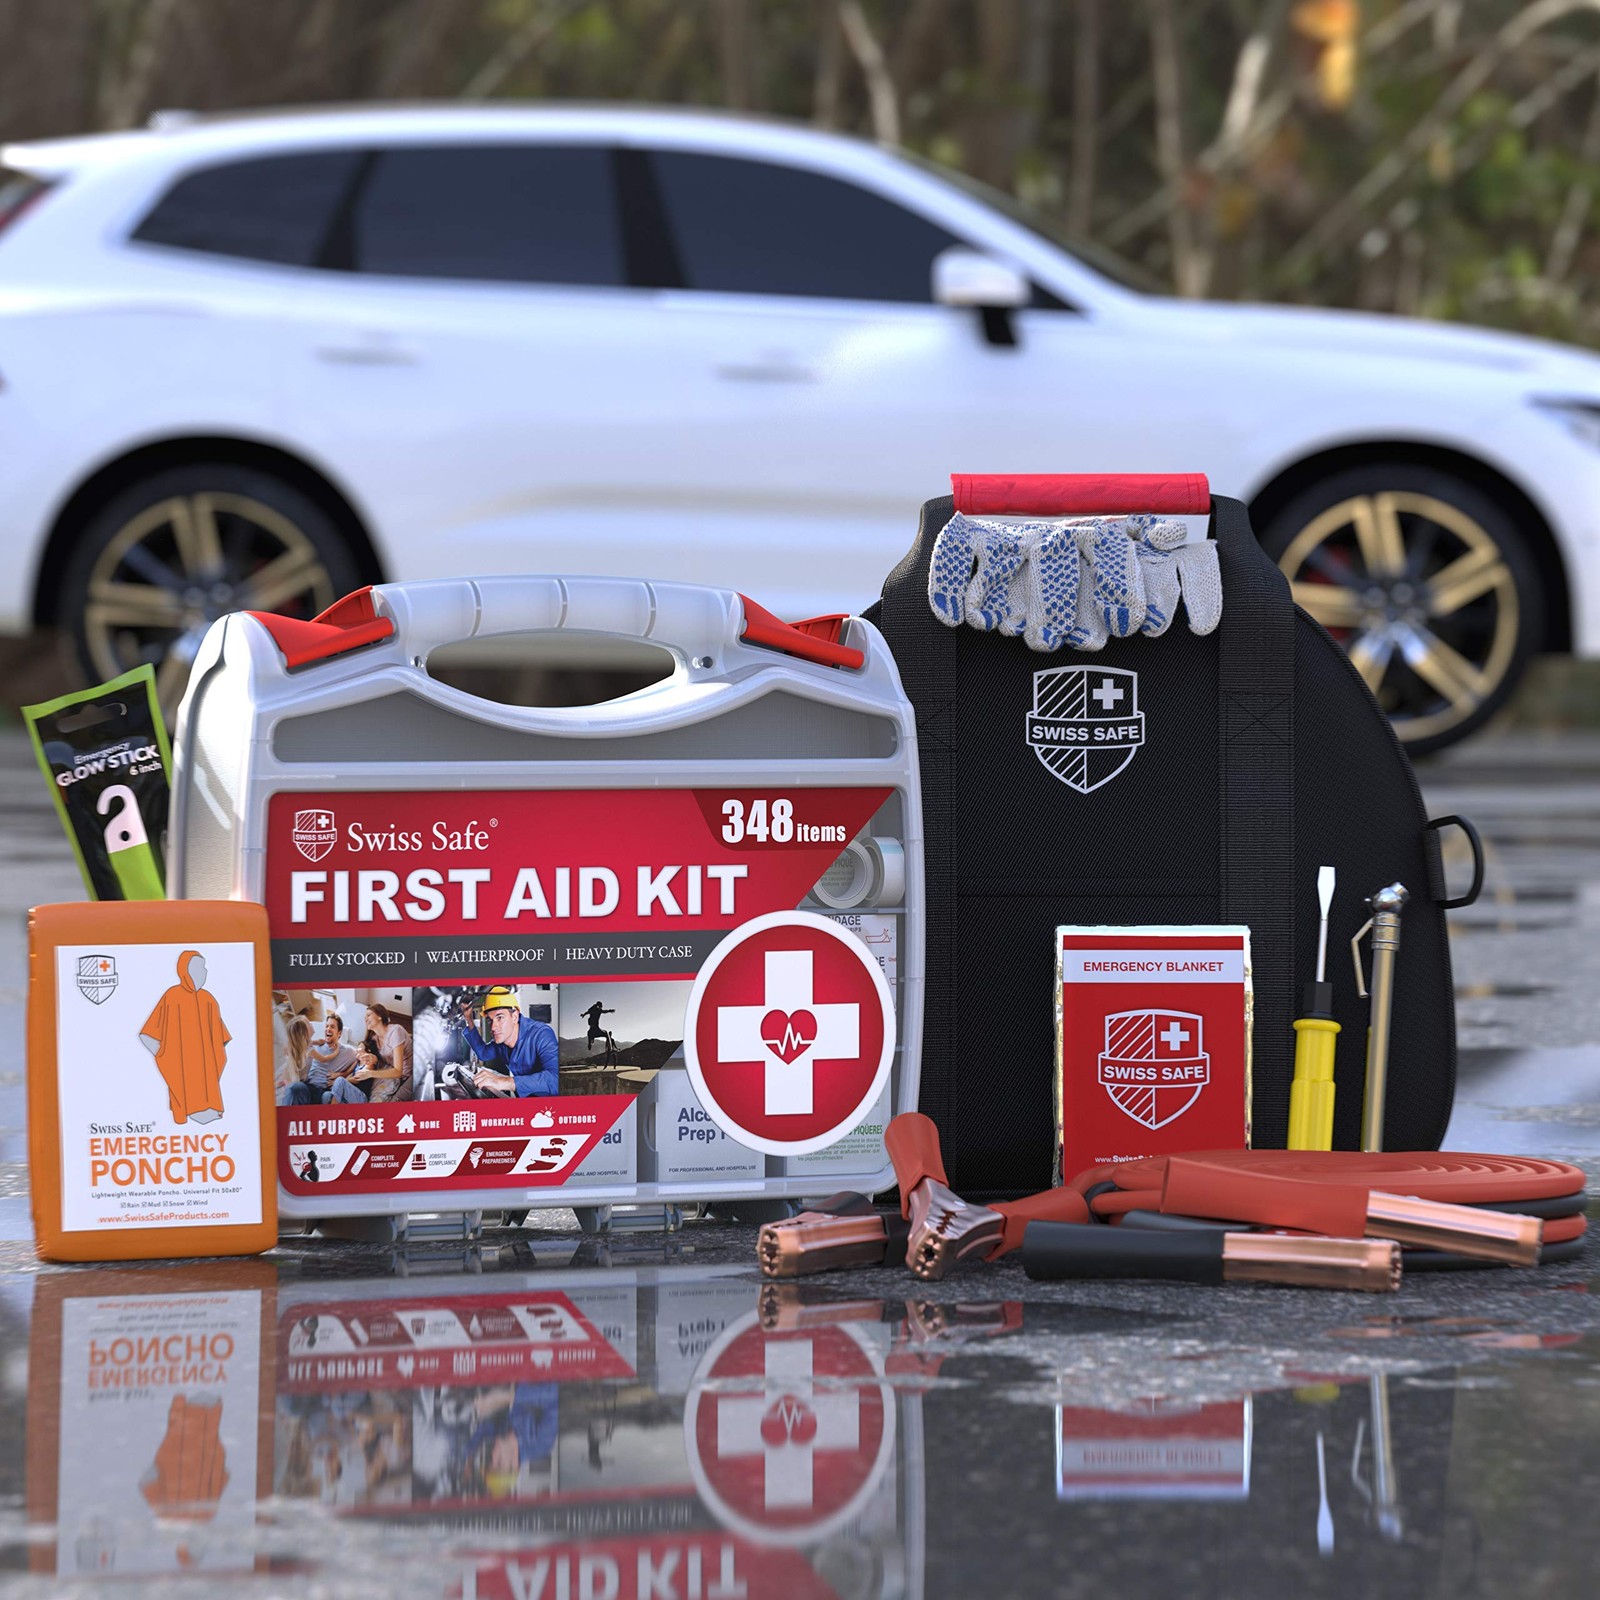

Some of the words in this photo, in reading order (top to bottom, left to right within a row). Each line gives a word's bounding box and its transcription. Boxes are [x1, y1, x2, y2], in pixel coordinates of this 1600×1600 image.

[1031, 725, 1089, 741] SWISS
[1093, 725, 1140, 741] SAFE
[74, 742, 130, 764] Emergency
[56, 759, 106, 787] GLOW
[107, 745, 160, 769] STICK
[129, 766, 139, 776] 6
[139, 761, 162, 773] inch
[721, 798, 794, 843] 348
[796, 822, 846, 842] items
[295, 833, 317, 841] SWISS
[317, 833, 336, 841] SAFE
[347, 823, 422, 852] Swiss
[291, 867, 491, 923] FIRST
[503, 866, 620, 920] AID
[636, 864, 748, 917] KIT
[289, 952, 334, 967] FULLY
[336, 951, 406, 966] STOCKED
[426, 948, 545, 964] WEATHERPROOF
[565, 946, 613, 961] HEAVY
[615, 945, 656, 960] DUTY
[657, 944, 693, 959] CASE
[1083, 962, 1163, 972] EMERGENCY
[1166, 961, 1224, 972] BLANKET
[100, 977, 116, 985] SAFE
[1103, 1065, 1157, 1081] SWISS
[1161, 1065, 1205, 1080] SAFE
[288, 1120, 313, 1137] ALL
[318, 1117, 385, 1136] PURPOSE
[419, 1120, 440, 1129] HOME
[481, 1117, 525, 1127] WORKPLACE
[558, 1115, 597, 1124] OUTDOORS
[602, 1129, 622, 1144] ad
[678, 1126, 716, 1144] Prep
[90, 1133, 229, 1157] EMERGENCY
[482, 1157, 516, 1165] PREPAREDNESS
[485, 1150, 513, 1158] EMERGENCY
[91, 1154, 236, 1187] PONCHO
[91, 1190, 127, 1199] Lightweight
[128, 1189, 157, 1197] Wearable
[183, 1187, 210, 1195] Universal
[98, 1210, 230, 1224] www.SwissSafeProducts.com
